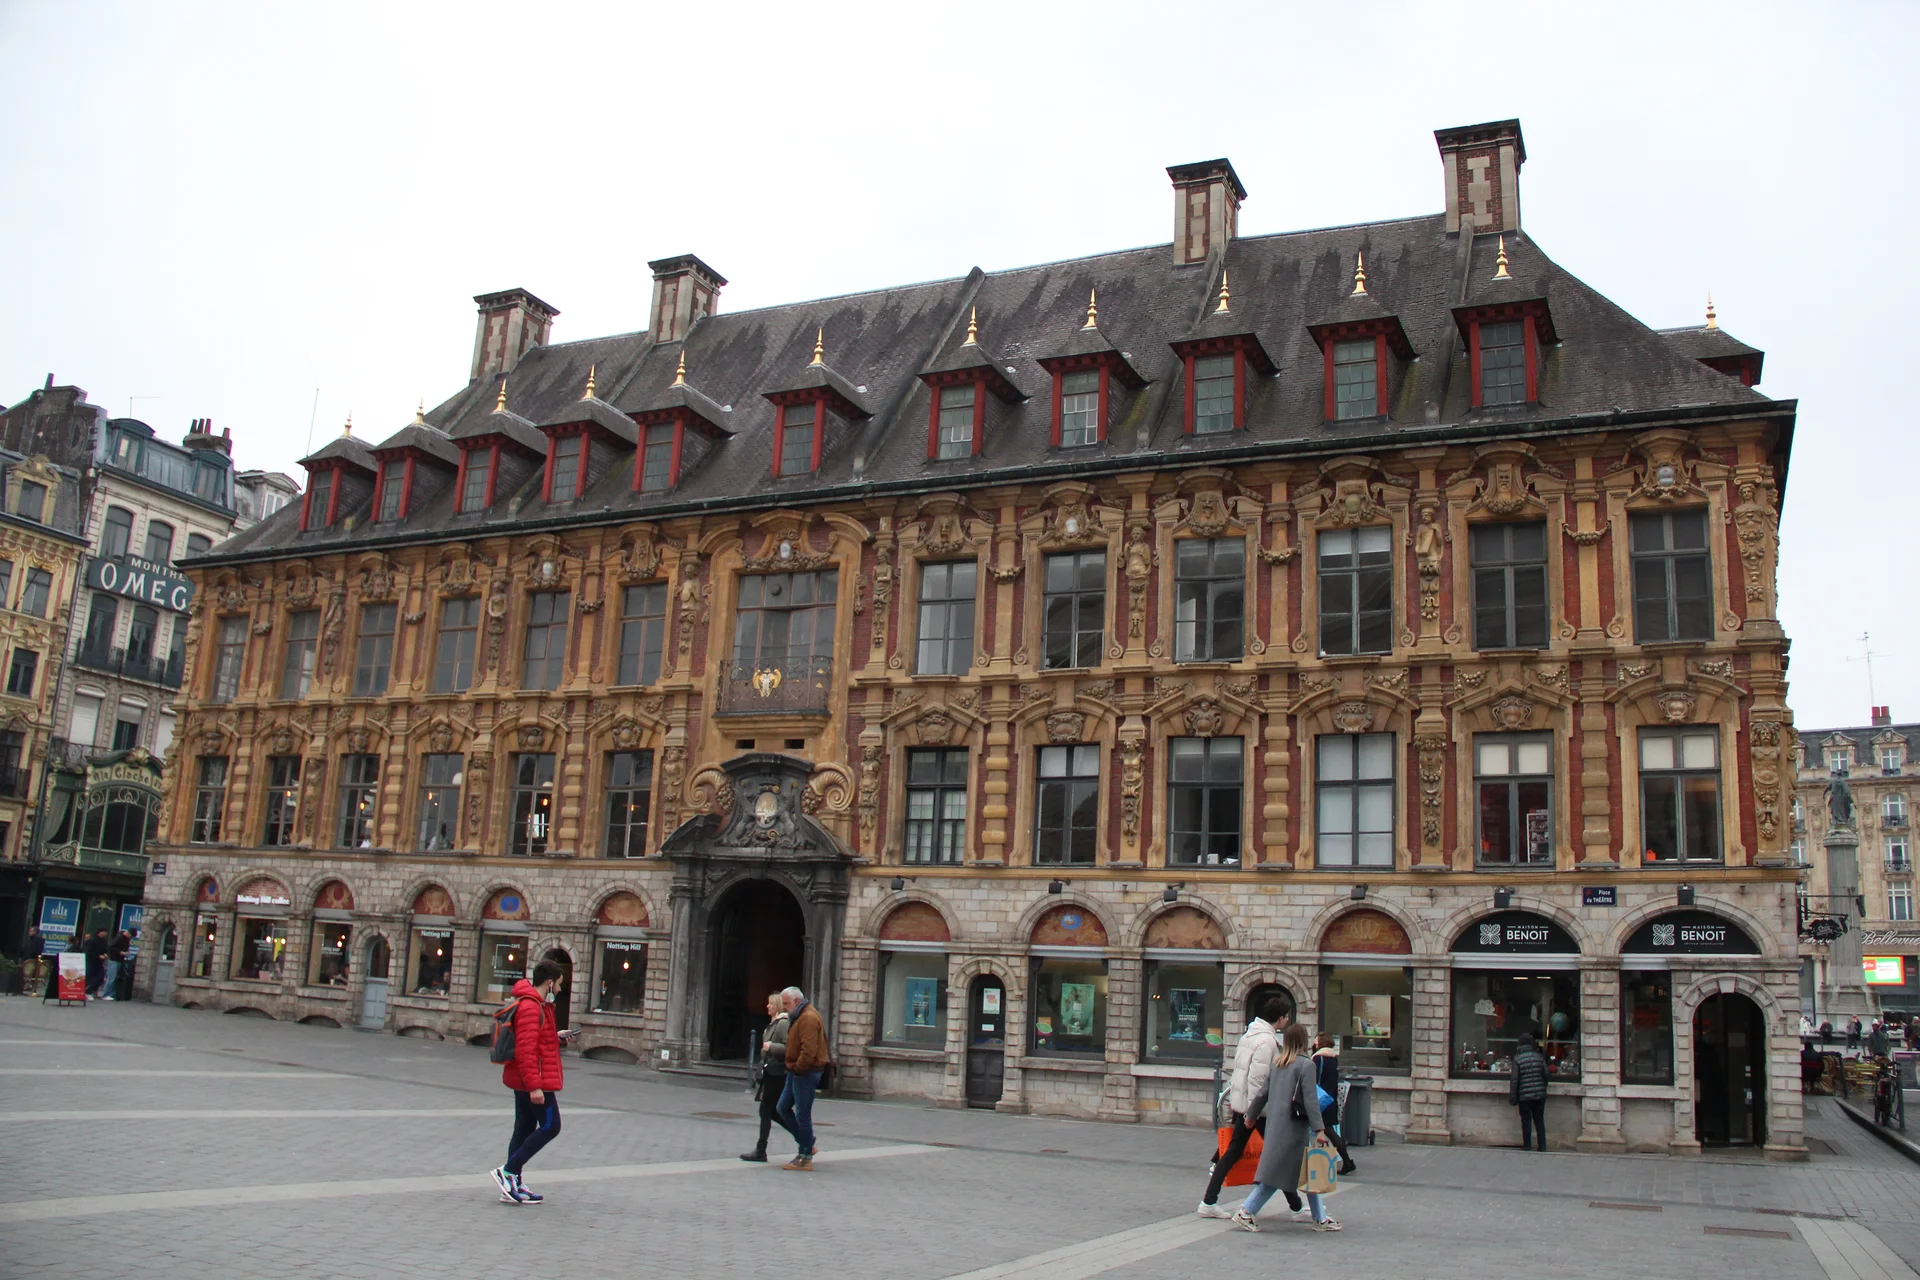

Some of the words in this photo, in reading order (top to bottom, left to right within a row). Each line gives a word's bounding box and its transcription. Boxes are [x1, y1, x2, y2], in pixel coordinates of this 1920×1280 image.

[100, 562, 189, 611] OMEG
[421, 930, 440, 939] Notting
[1506, 930, 1549, 940] BENOIT
[1681, 930, 1726, 941] BENOIT
[1861, 930, 1920, 946] Bellevue
[607, 942, 630, 951] Notting
[630, 943, 642, 951] Hill
